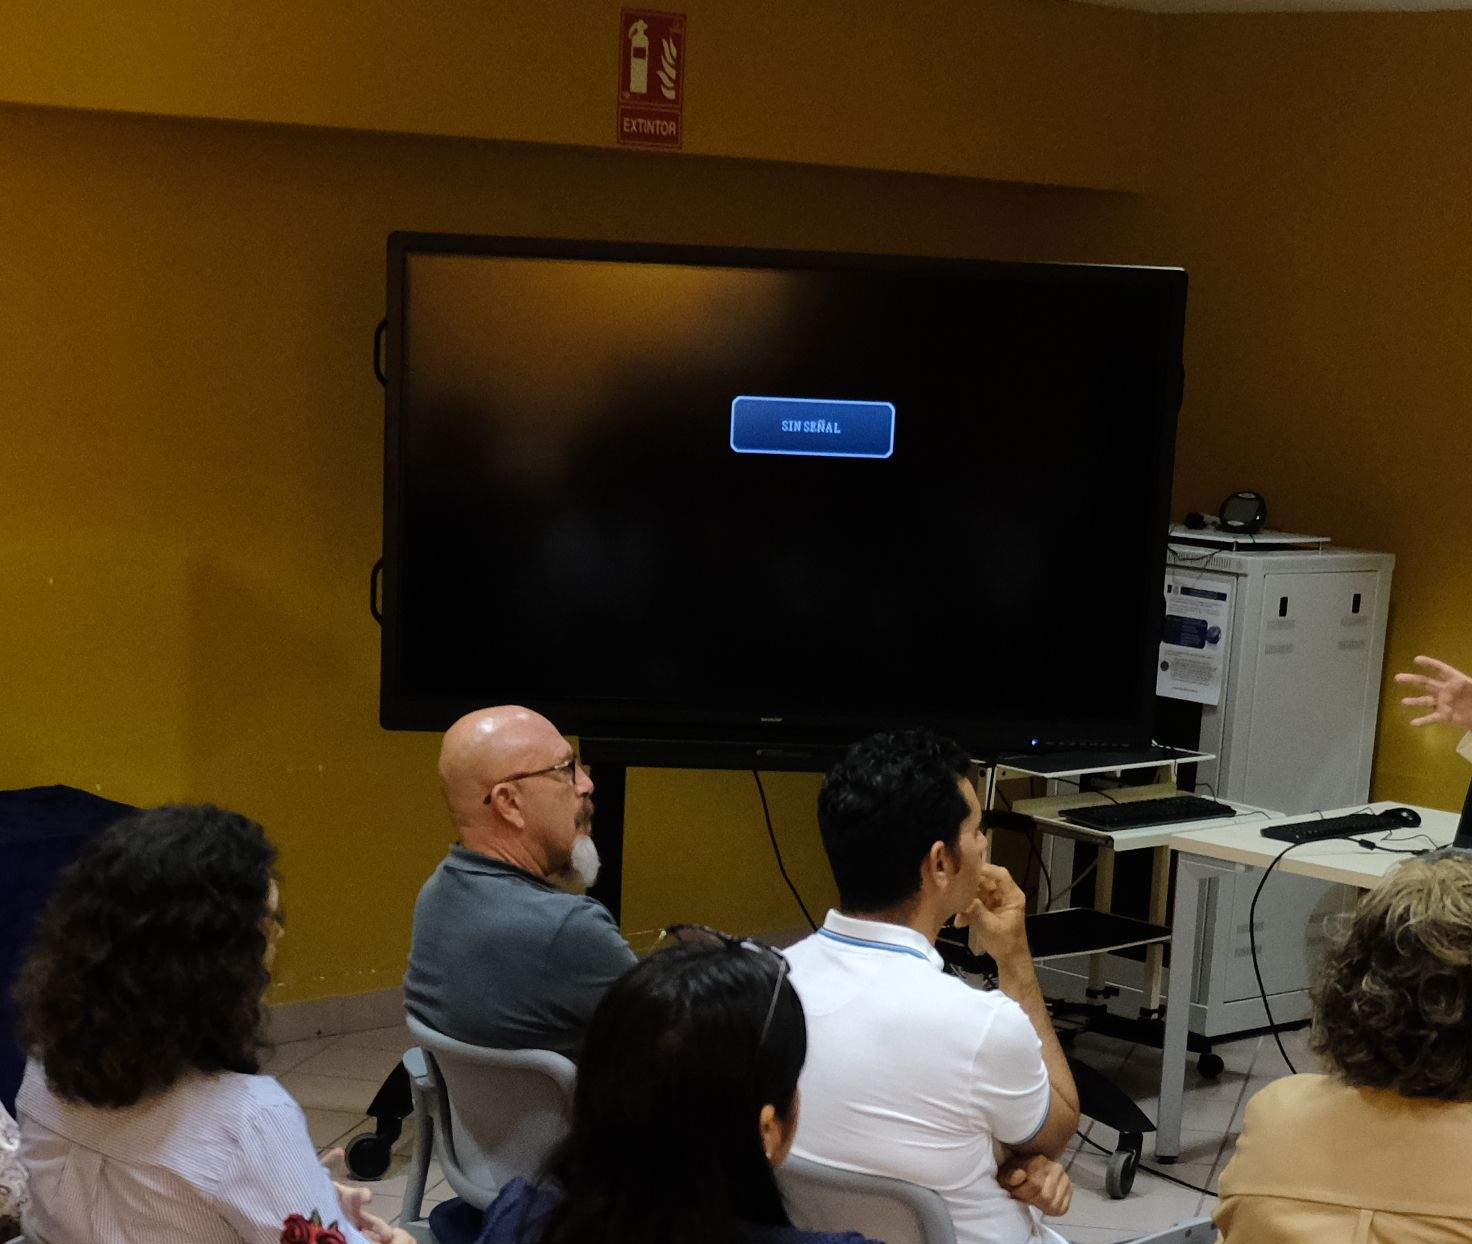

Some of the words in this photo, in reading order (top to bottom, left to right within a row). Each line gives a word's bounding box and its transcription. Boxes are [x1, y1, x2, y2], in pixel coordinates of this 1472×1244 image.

[624, 117, 676, 136] EXTINTOR
[782, 420, 802, 432] SIN
[803, 419, 841, 434] SEÑAL
